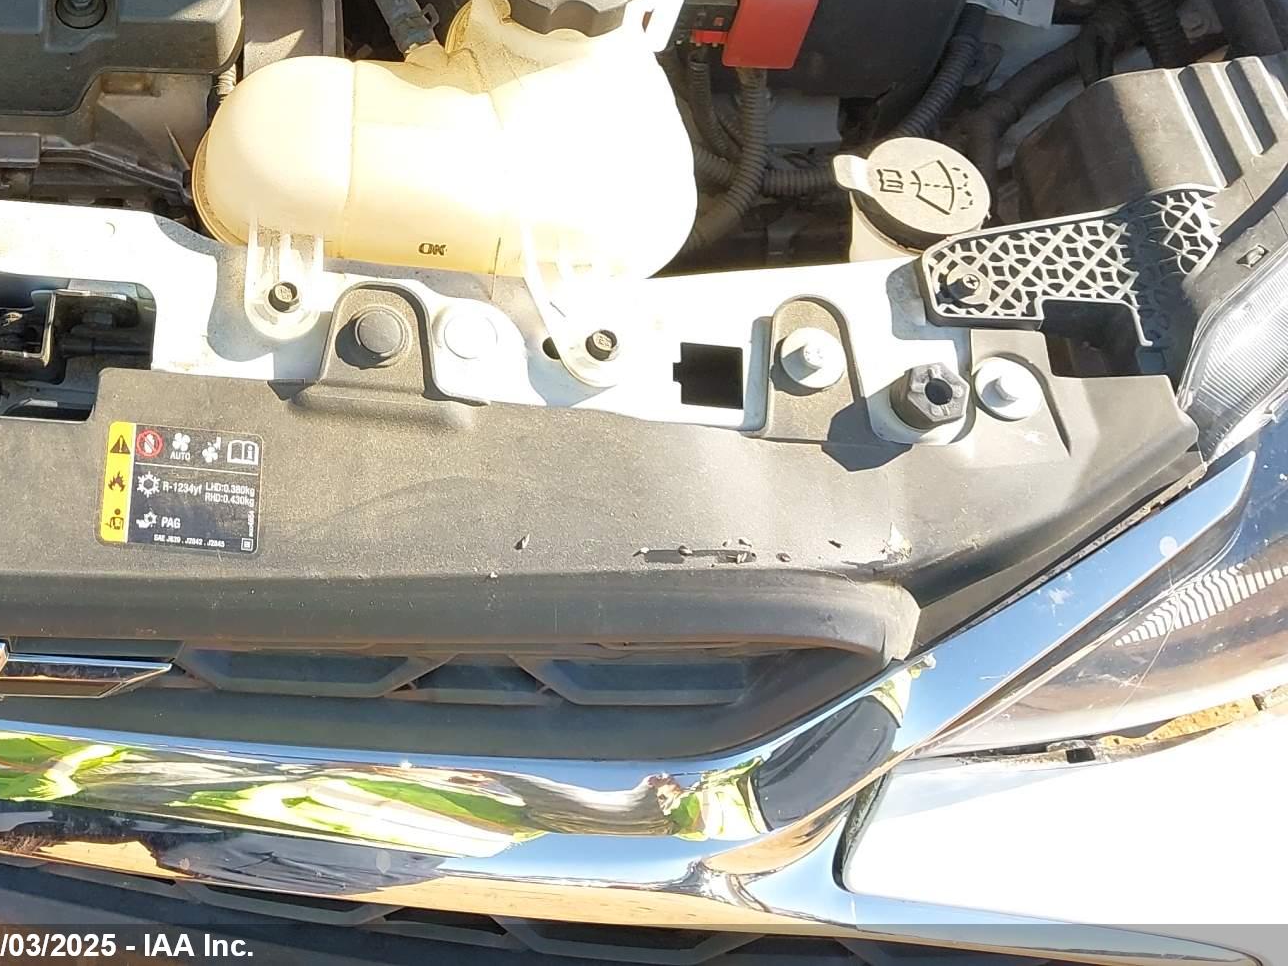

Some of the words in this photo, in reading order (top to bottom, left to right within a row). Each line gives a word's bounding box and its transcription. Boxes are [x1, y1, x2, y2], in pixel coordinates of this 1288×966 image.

[170, 451, 191, 461] AUTO
[162, 481, 202, 496] R-1234yf
[205, 482, 255, 497] LHD:0.380kg
[204, 492, 255, 508] RHD:0.430kg
[161, 516, 181, 529] PAG
